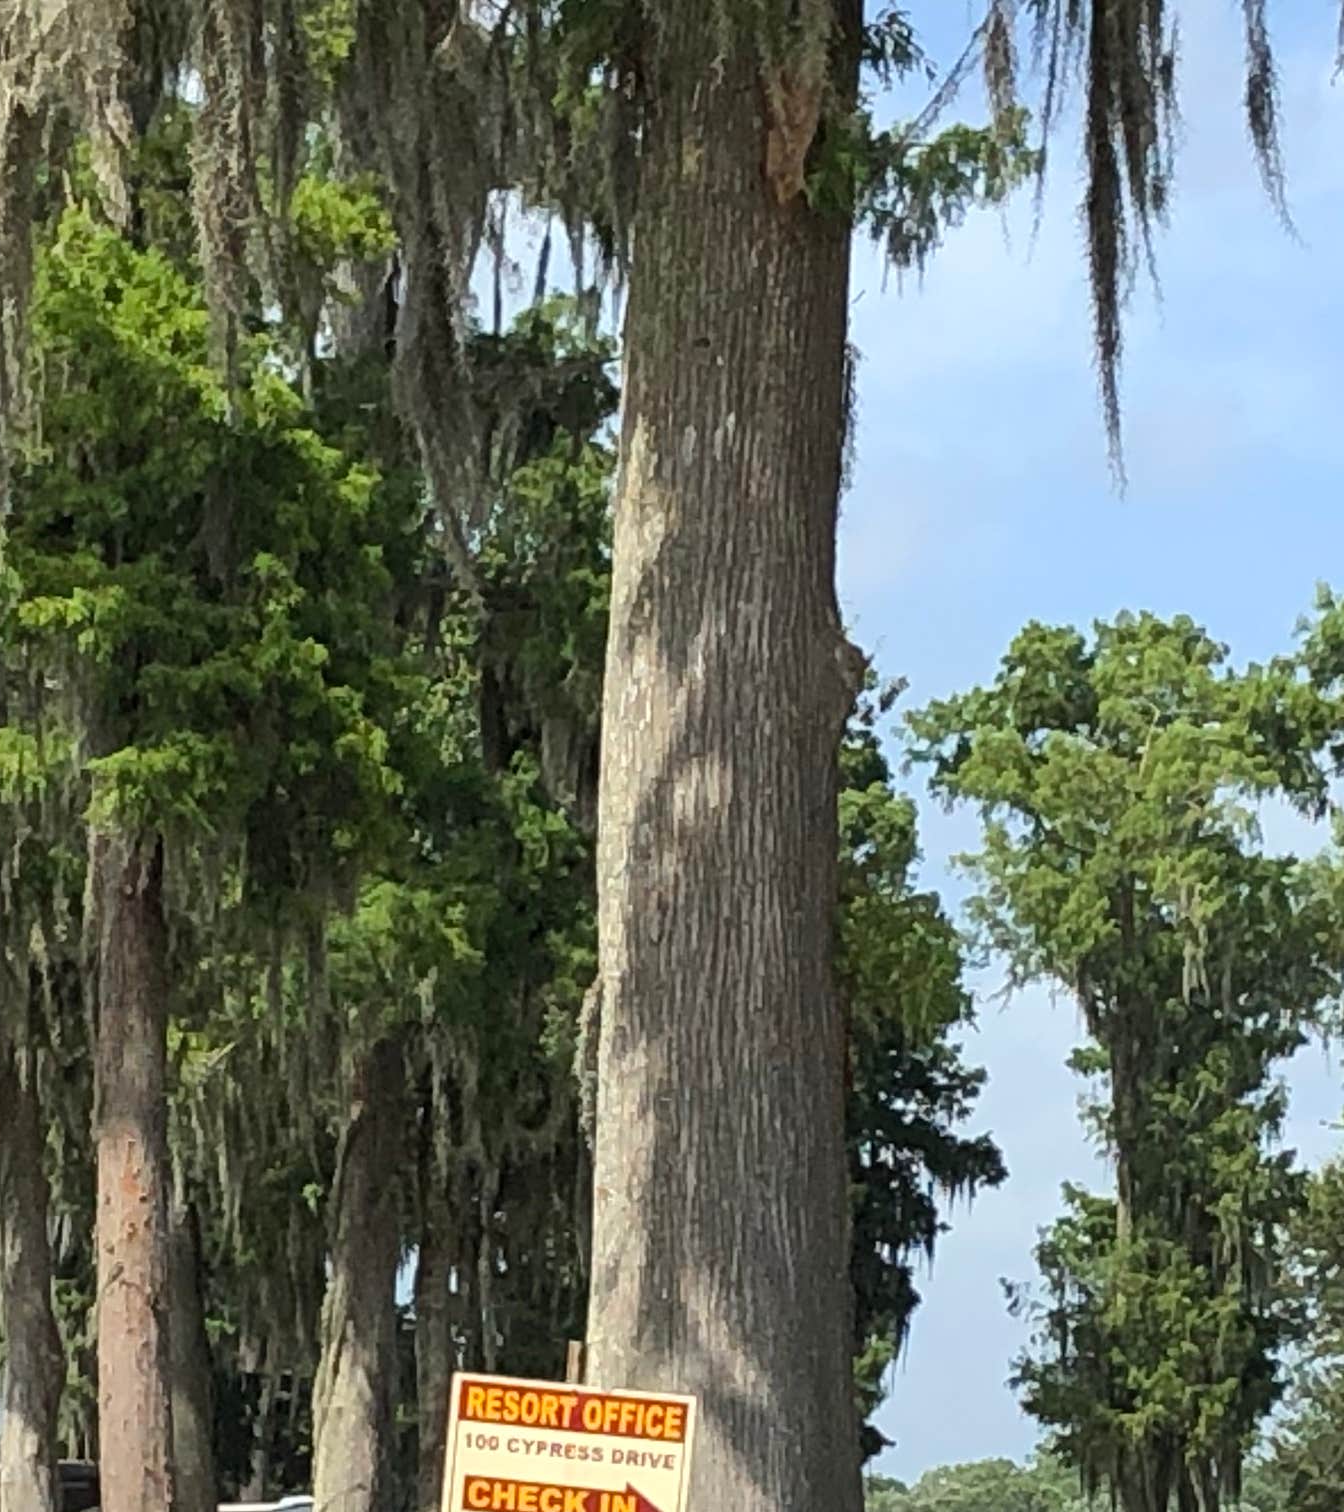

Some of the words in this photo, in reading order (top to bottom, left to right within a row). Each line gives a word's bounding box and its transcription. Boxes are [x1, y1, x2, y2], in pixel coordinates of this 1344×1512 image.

[467, 1386, 577, 1427] RESORT
[582, 1400, 682, 1438] OFFICE
[465, 1433, 499, 1451] 100
[507, 1438, 604, 1462] CYPRESS
[611, 1449, 676, 1470] DRIVE
